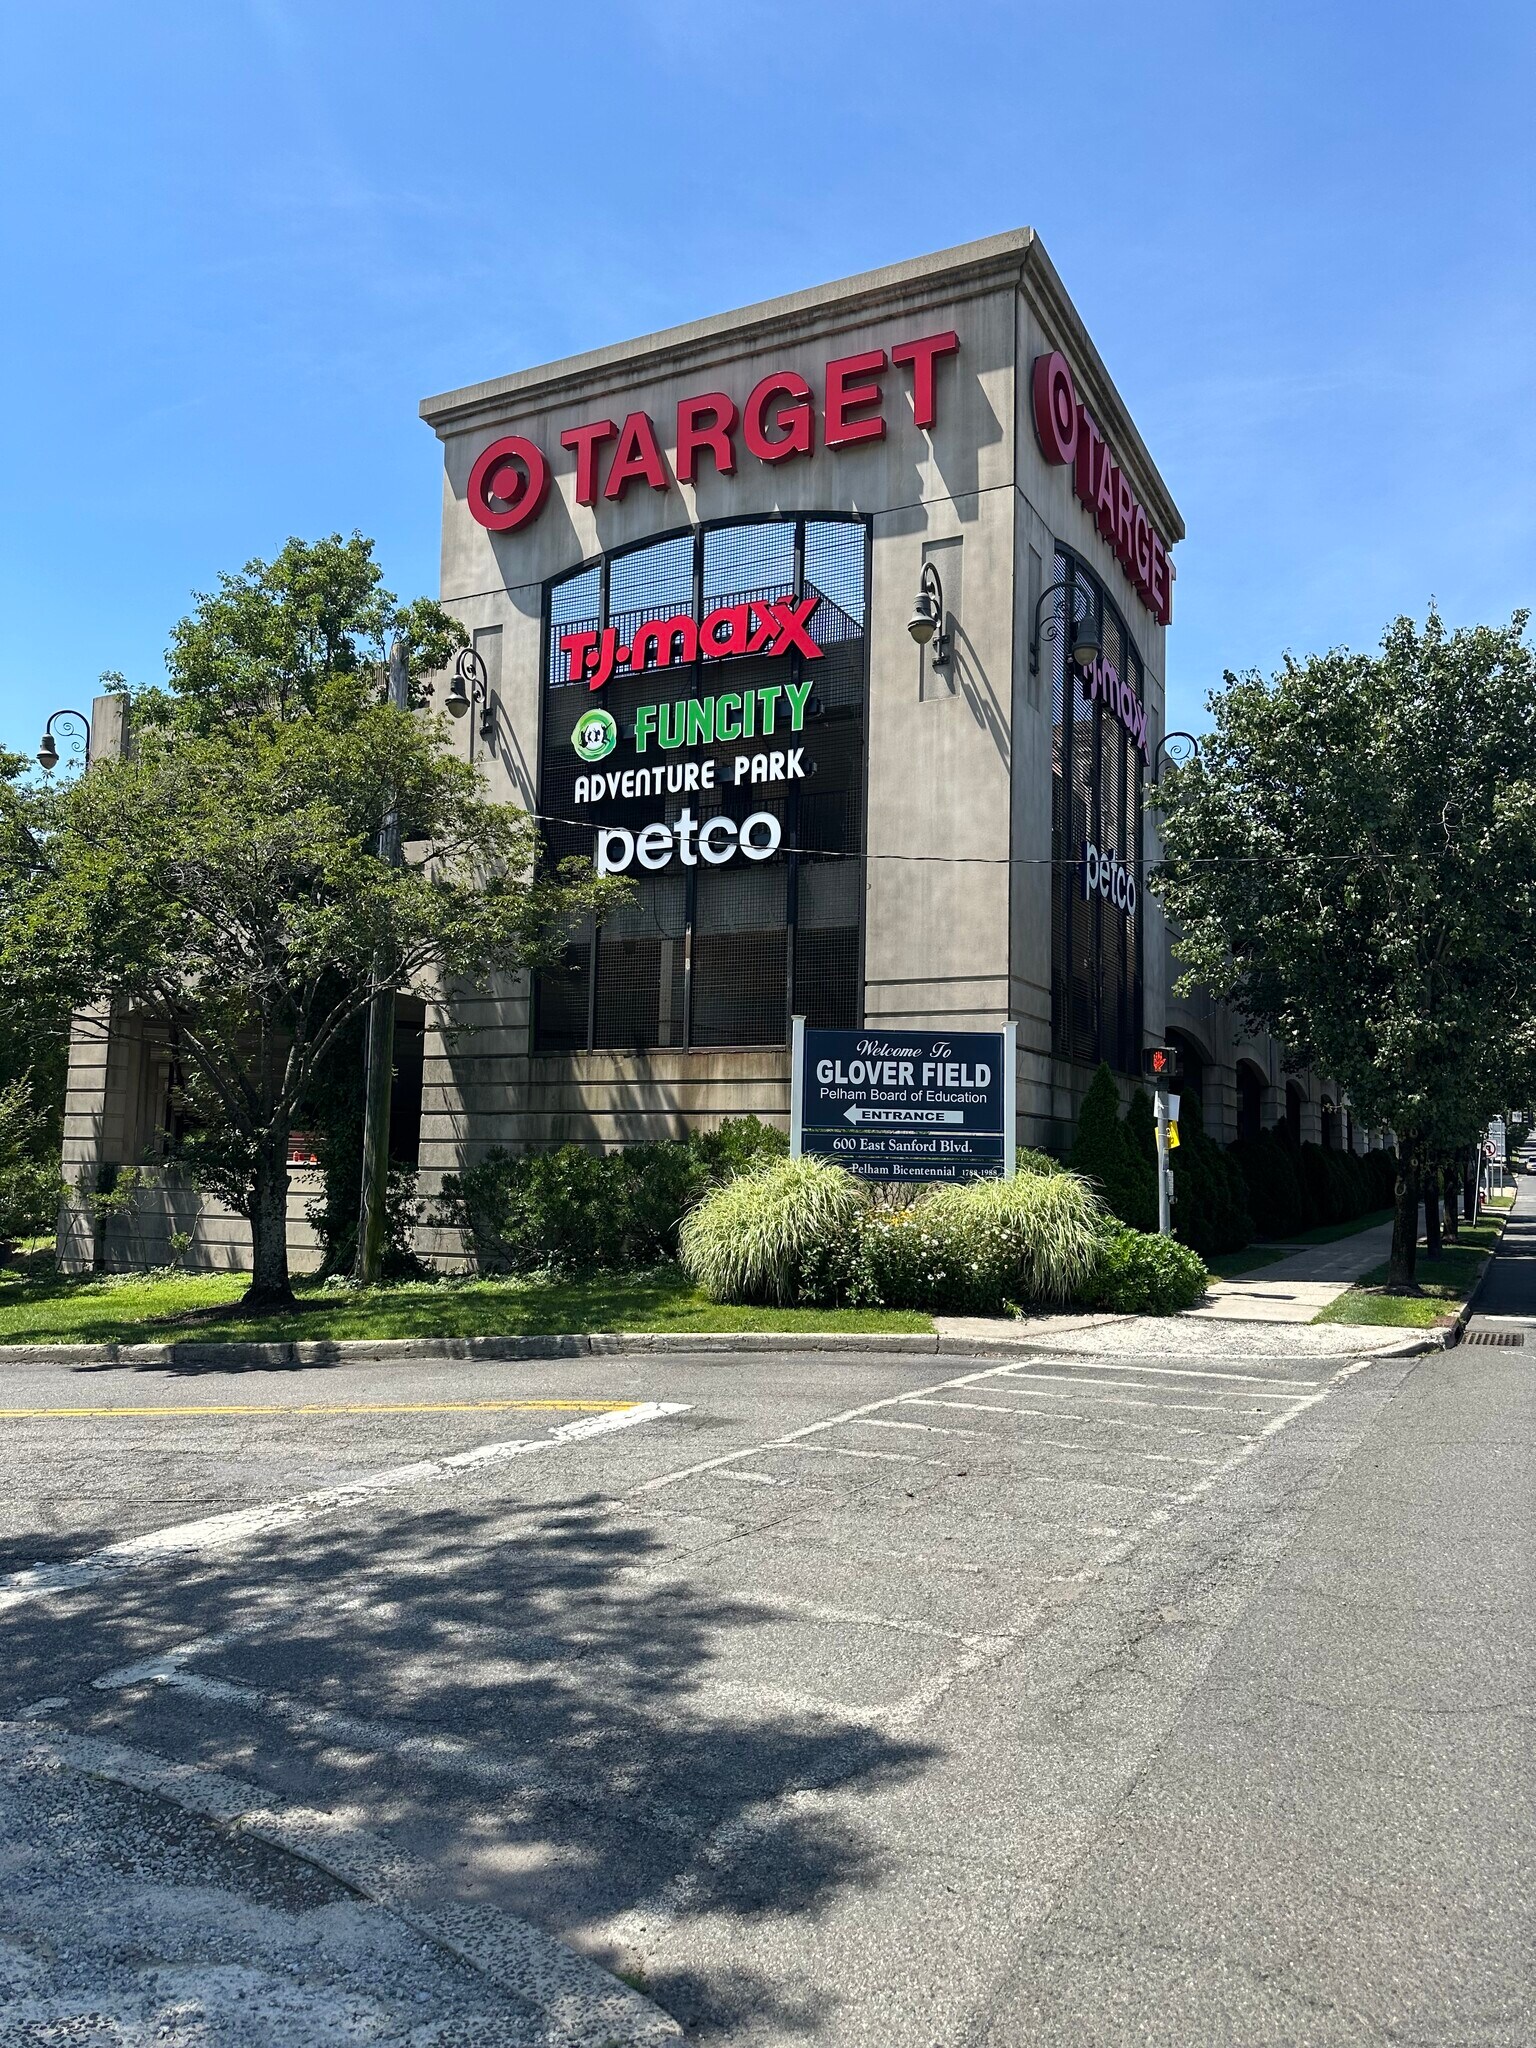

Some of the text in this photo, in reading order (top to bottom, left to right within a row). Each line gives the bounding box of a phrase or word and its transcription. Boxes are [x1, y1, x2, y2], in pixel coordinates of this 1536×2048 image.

[560, 330, 960, 508] TARGET
[1077, 403, 1177, 627] TARGET
[634, 680, 814, 753] FUNCITY
[574, 747, 806, 804] ADVENTURE PARK
[597, 807, 782, 879] petco
[1086, 841, 1136, 915] petco
[856, 1039, 952, 1058] Welcome To
[816, 1059, 992, 1088] GLOVER FIELD
[820, 1087, 987, 1104] Pelham Board of Education
[861, 1110, 945, 1121] ENTRANCE
[833, 1137, 973, 1153] 600 East Sanford Blvd.
[851, 1163, 889, 1175] Pelham
[893, 1164, 955, 1176] Bicentennial
